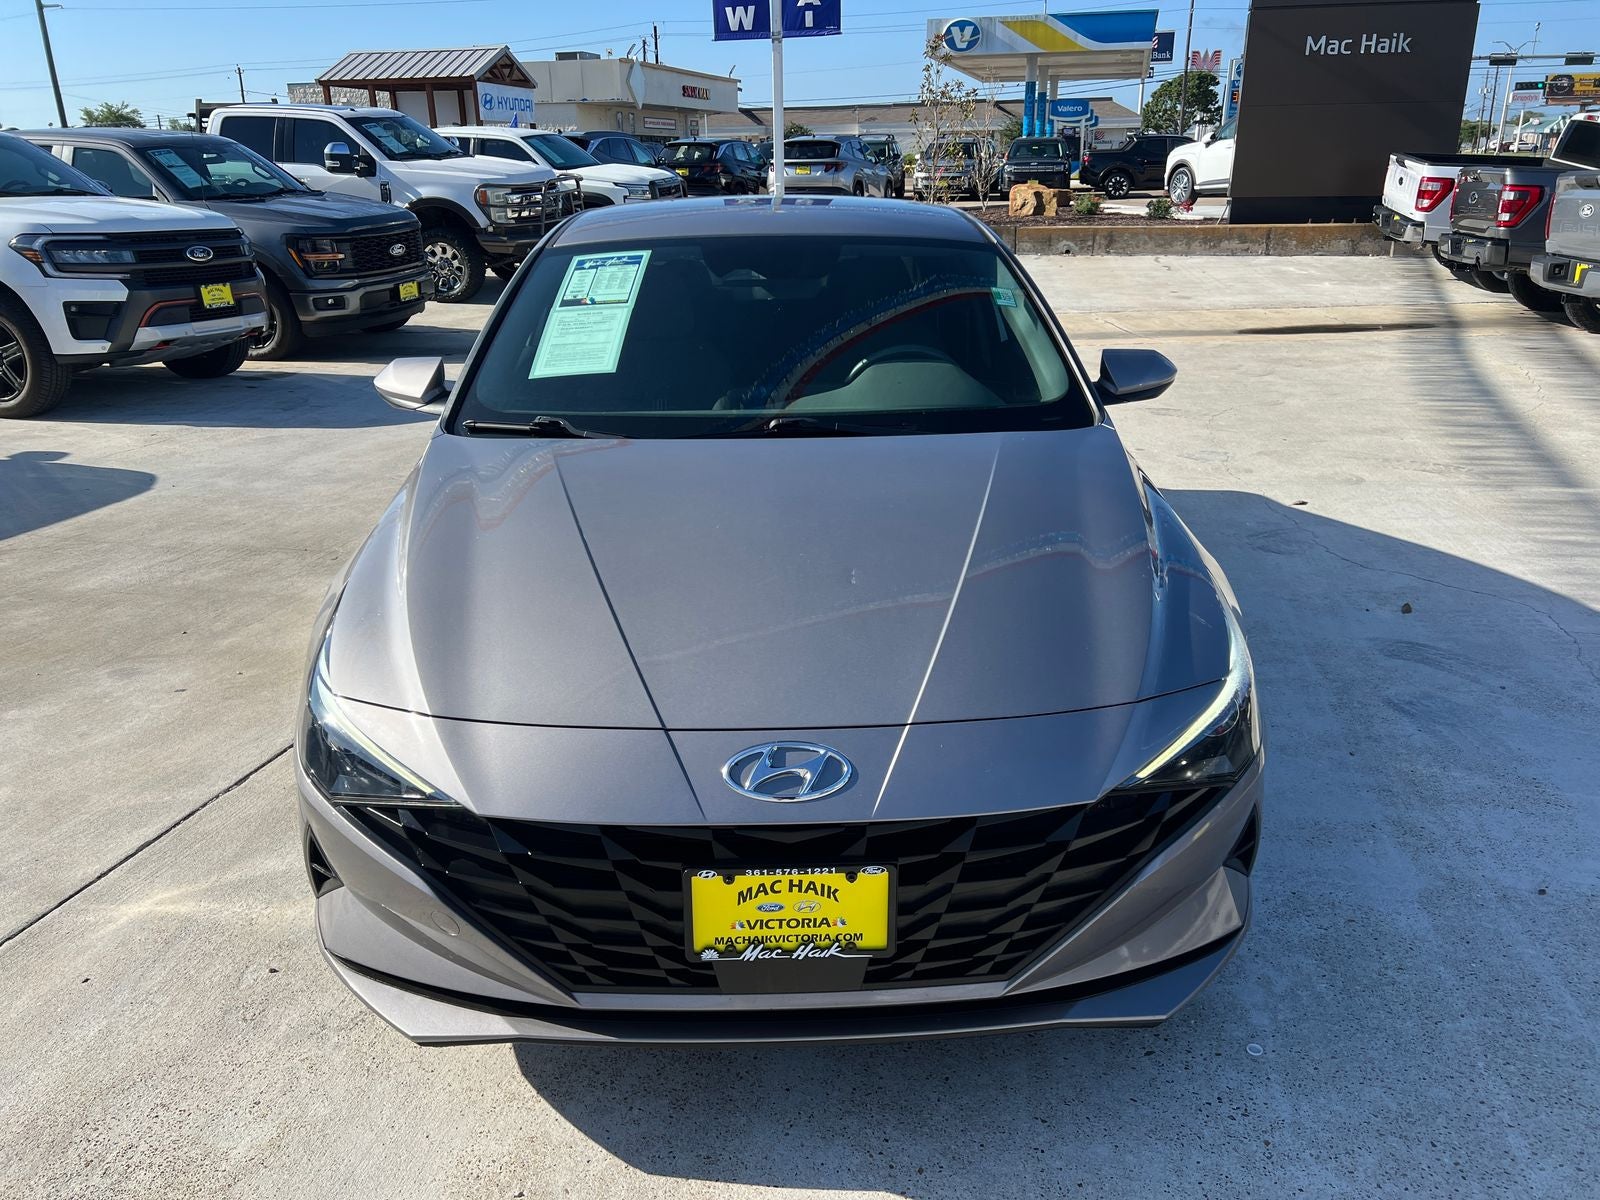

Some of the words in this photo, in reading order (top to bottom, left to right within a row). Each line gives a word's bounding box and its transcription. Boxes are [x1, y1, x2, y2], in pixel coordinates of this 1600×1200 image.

[1305, 35, 1353, 56] Mac
[1360, 32, 1413, 54] Haik
[497, 96, 534, 112] HYUNDAI
[1057, 104, 1083, 112] Valero
[745, 867, 837, 876] 361-576-1221
[737, 879, 782, 906] MAC
[788, 879, 840, 903] HAIK
[745, 917, 831, 930] VICTORIA
[714, 933, 863, 945] MACHAIKVICTORIA.COM
[739, 944, 790, 962] Mac
[791, 942, 848, 960] Haik
